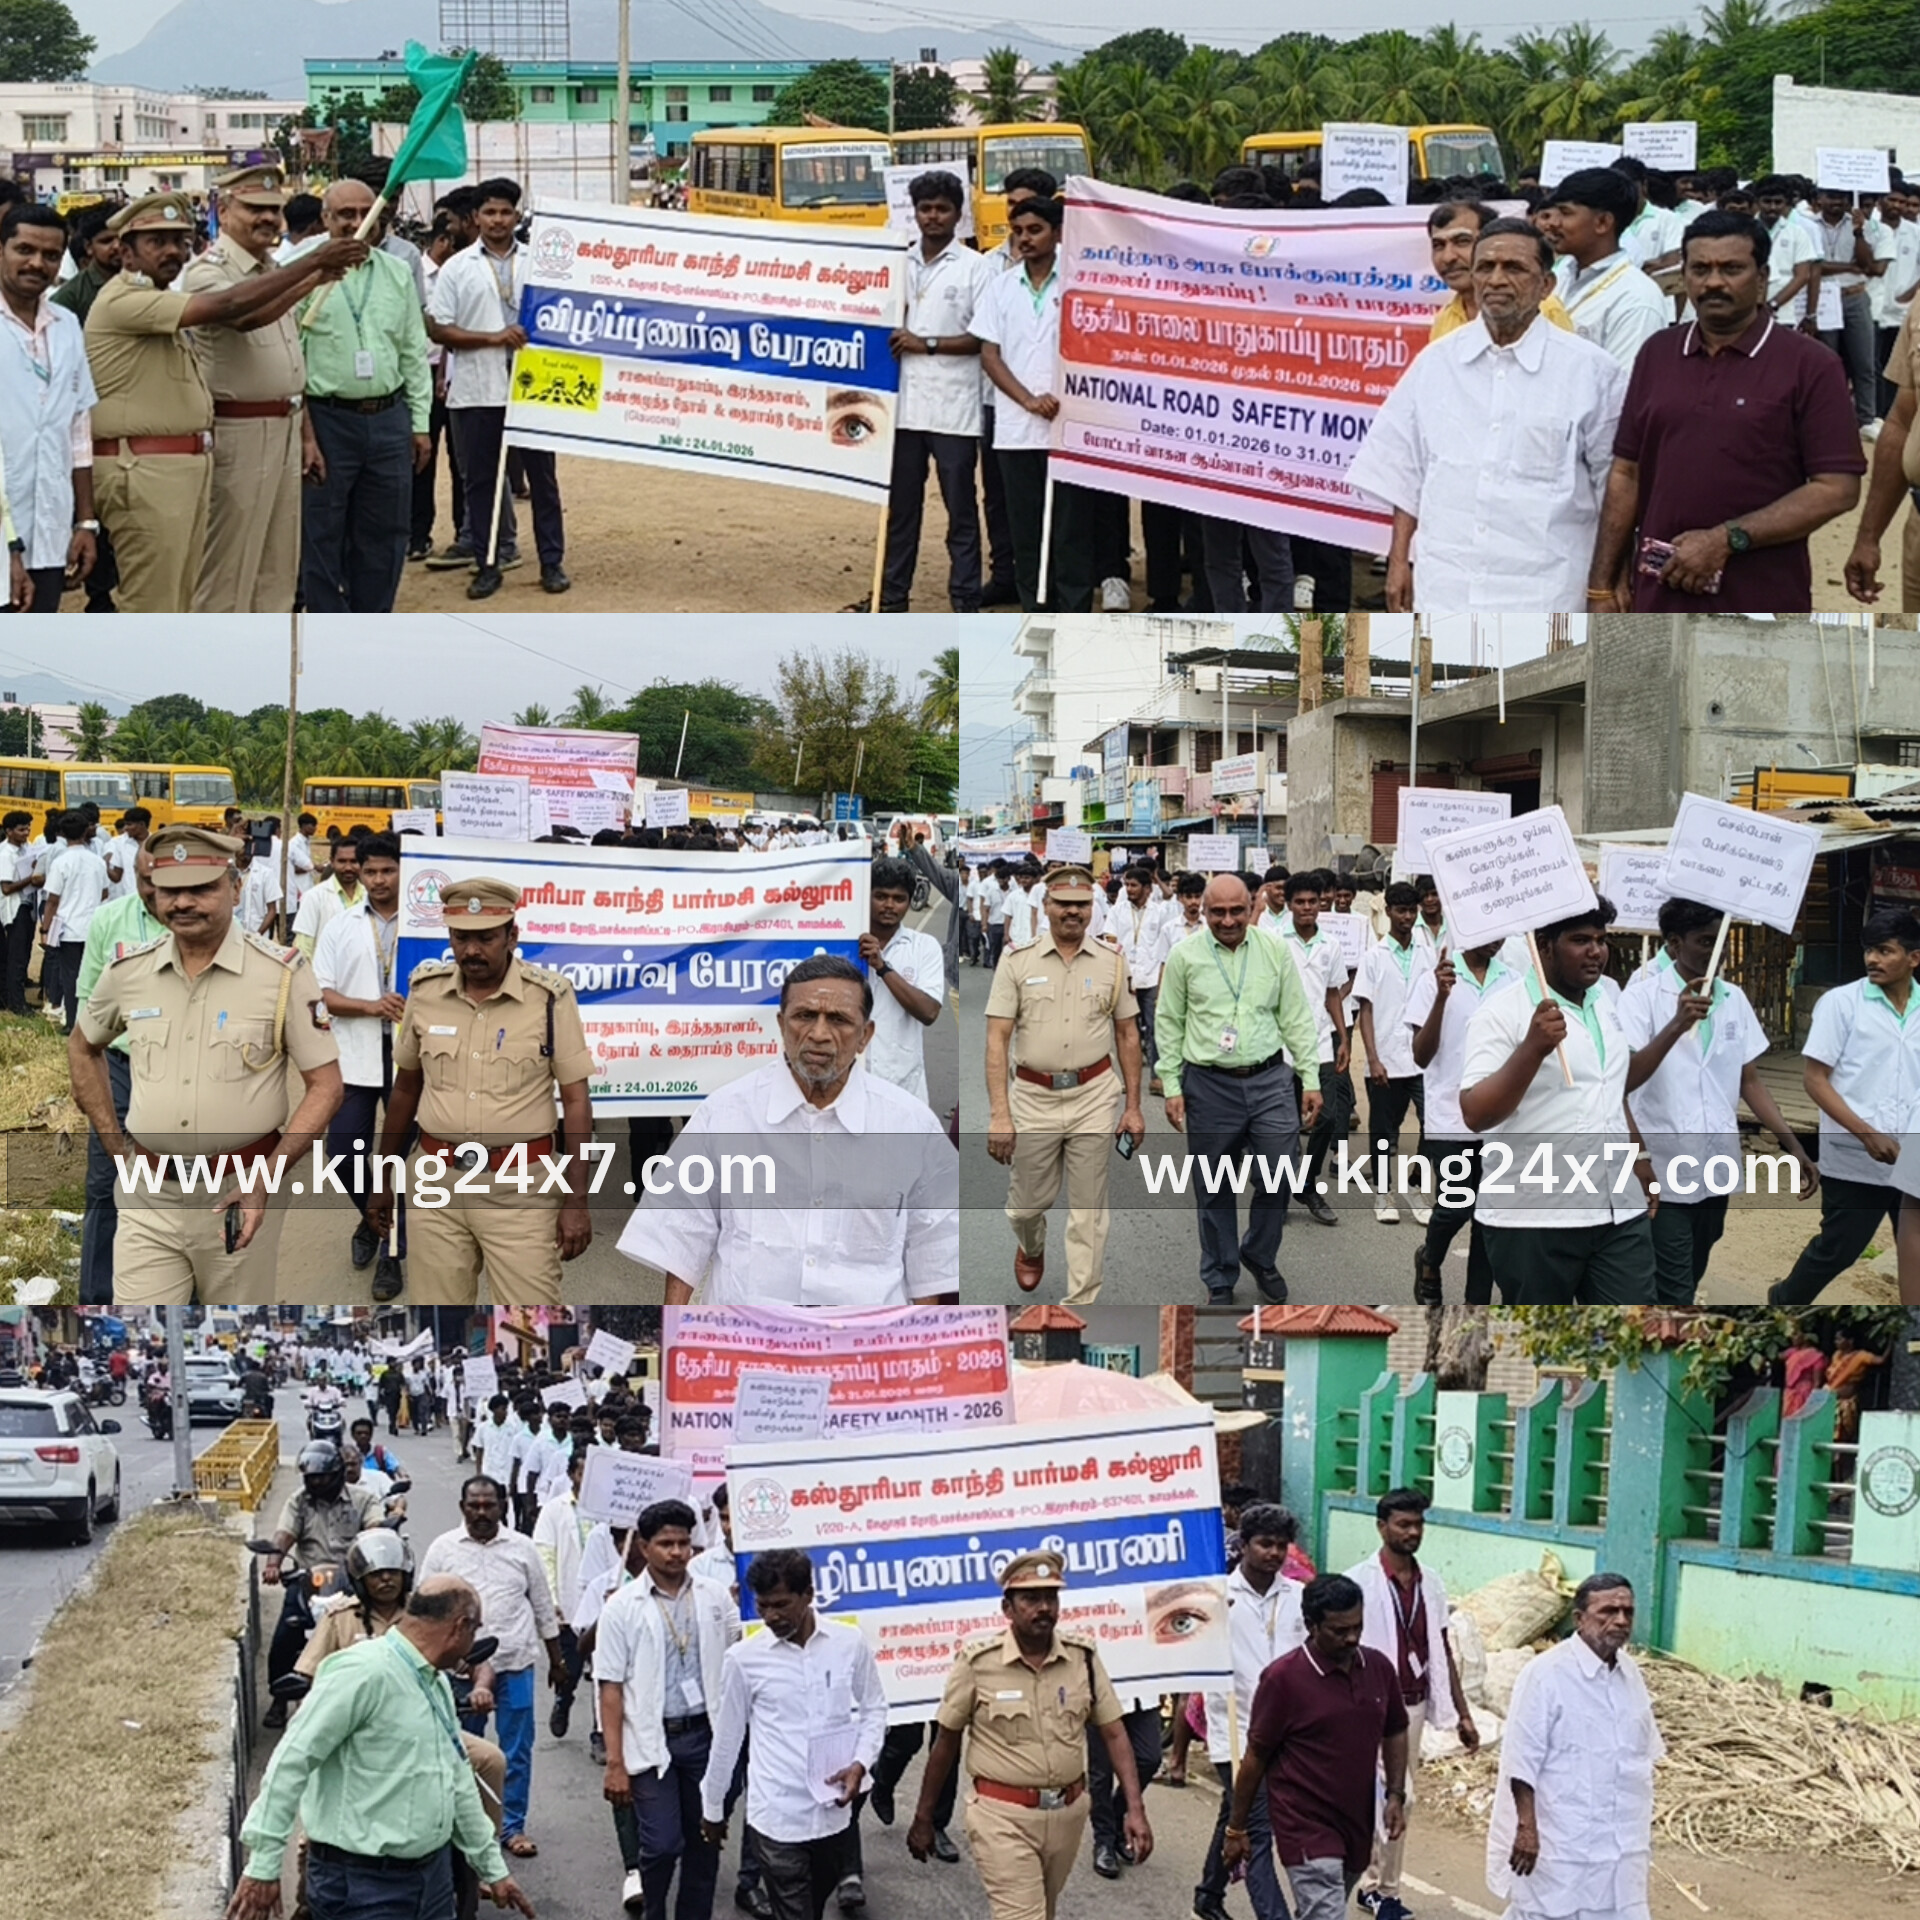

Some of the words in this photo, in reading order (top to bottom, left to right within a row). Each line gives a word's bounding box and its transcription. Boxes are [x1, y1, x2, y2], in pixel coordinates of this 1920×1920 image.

[576, 238, 679, 270] கஸ்தூரிபா
[683, 251, 741, 279] காந்தி
[745, 258, 812, 281] பார்மசி
[817, 262, 890, 295] கல்லூரி
[1080, 244, 1179, 270] தமிழ்நாடு
[1182, 257, 1234, 275] அரசு
[1239, 262, 1413, 292] போக்குவரத்து
[1075, 270, 1151, 290] சாலைப்
[1294, 291, 1349, 310] உயிர்
[1355, 299, 1441, 318] பாதுகா
[536, 297, 741, 361] விழிப்புணர்வு
[749, 322, 866, 371] பேரணி
[1070, 296, 1131, 335] தேசிய
[1137, 312, 1202, 343] சாலை
[1206, 316, 1321, 366] பாதுகாப்பு
[1327, 325, 1410, 372] மாதம்
[1151, 352, 1228, 375] 01.01.2026
[1231, 364, 1272, 381] முதல்
[1274, 368, 1361, 393] 31.01.2026
[1064, 373, 1158, 410] NATIONAL
[1162, 387, 1221, 419] ROAD
[1231, 398, 1317, 435] SAFETY
[1321, 411, 1374, 443] MON
[693, 438, 755, 457] 24.01.2026
[1083, 431, 1141, 455] மோட்டார்
[1143, 444, 1188, 464] வாகன
[1190, 452, 1265, 479] ஆய்வாளர்
[1140, 418, 1181, 438] Date:
[1184, 426, 1271, 454] 01.01.2026
[1274, 442, 1292, 457] to
[545, 788, 575, 799] SAFETY
[1717, 816, 1783, 844] செல்போன்
[1444, 835, 1518, 863] கண்களுக்கு
[1701, 836, 1785, 872] பேசிக்கொண்டு
[1680, 857, 1727, 879] வாகனம்
[593, 885, 665, 915] காந்தி
[672, 886, 755, 910] பார்மசி
[763, 877, 853, 912] கல்லூரி
[665, 1017, 764, 1037] இரத்ததானம்,
[597, 1041, 640, 1062] நோய்
[649, 1042, 663, 1057] &
[667, 1041, 733, 1060] தைராய்டு
[736, 1038, 778, 1058] நோய்
[624, 1080, 698, 1094] 24.01.2026
[676, 1351, 731, 1383] தேசிய
[883, 1349, 943, 1382] மாதம்
[956, 1349, 1004, 1372] 2026
[671, 1408, 733, 1430] NATION
[963, 1400, 1003, 1421] 2026
[790, 1475, 923, 1513] கஸ்தூரிபா
[931, 1466, 1005, 1499] காந்தி
[1013, 1456, 1099, 1488] பார்மசி
[1107, 1445, 1203, 1483] கல்லூரி
[1100, 1621, 1144, 1641] நோய்
[895, 1663, 953, 1680] (Glaucom
